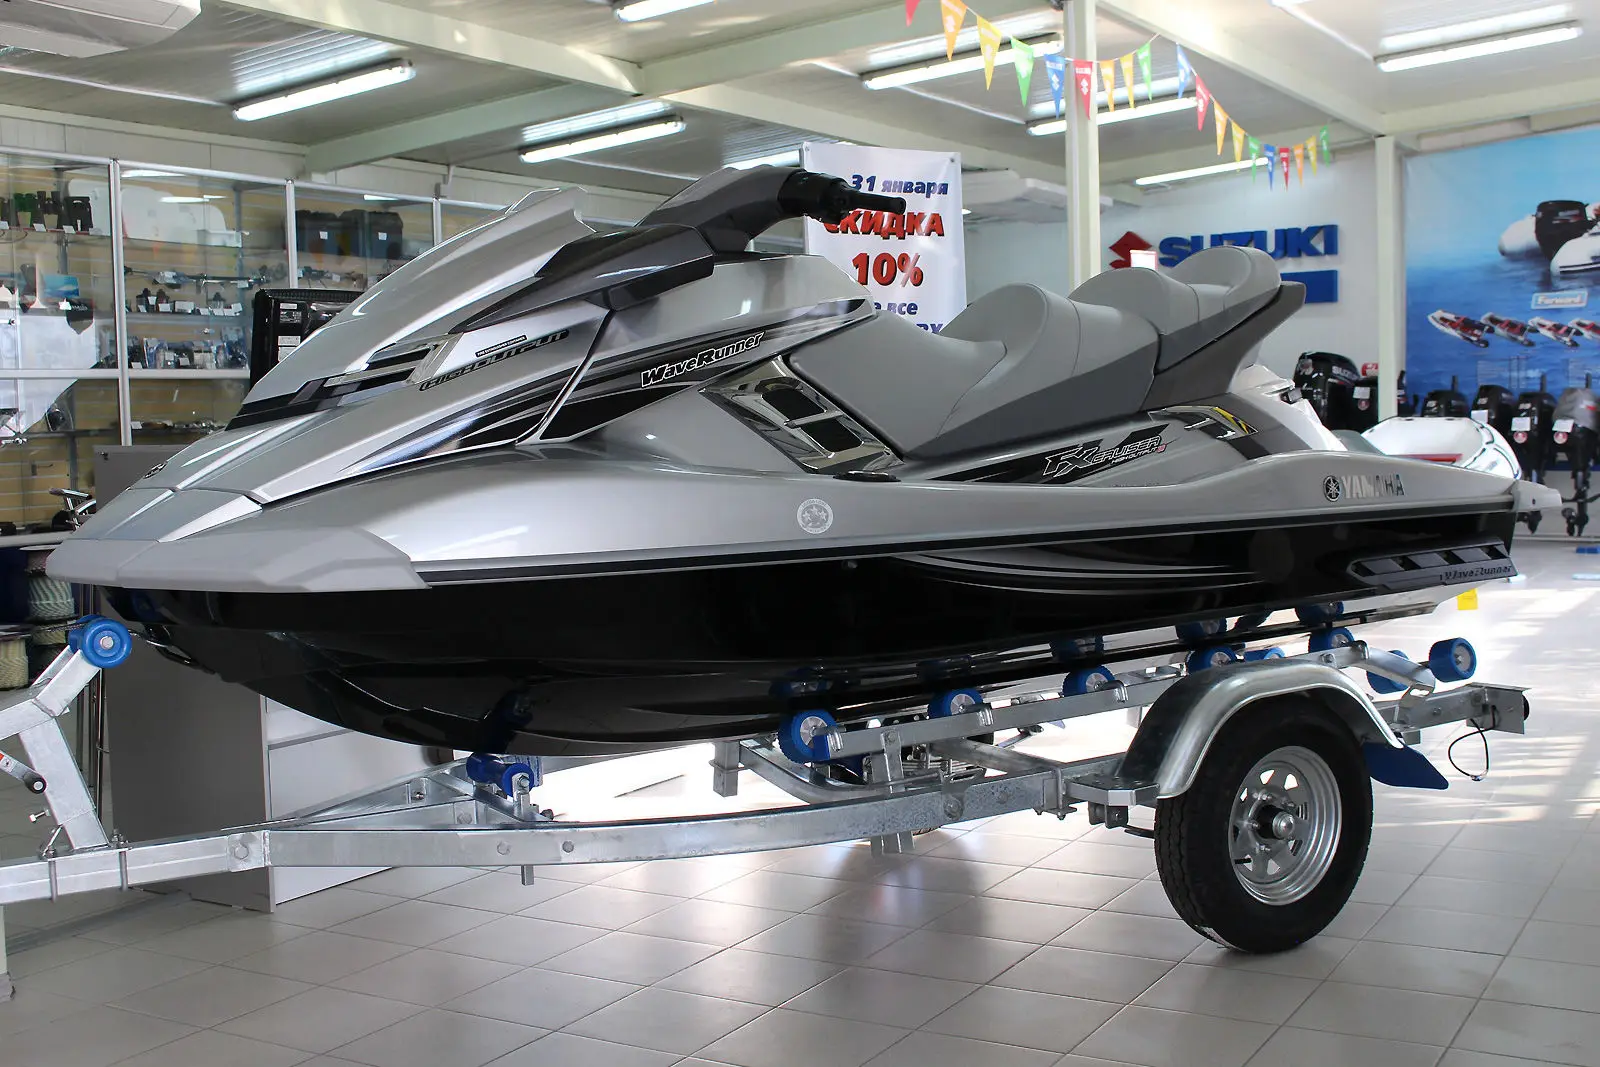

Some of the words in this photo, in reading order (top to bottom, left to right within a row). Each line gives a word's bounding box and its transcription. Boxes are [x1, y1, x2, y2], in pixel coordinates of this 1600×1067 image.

[851, 174, 877, 192] 31
[881, 179, 949, 198] января
[851, 252, 924, 288] 10%
[887, 303, 918, 316] все
[641, 331, 765, 388] WaveRunner
[1042, 446, 1098, 478] FX
[1092, 435, 1161, 464] CRUISER
[1341, 474, 1405, 499] YAMAHA
